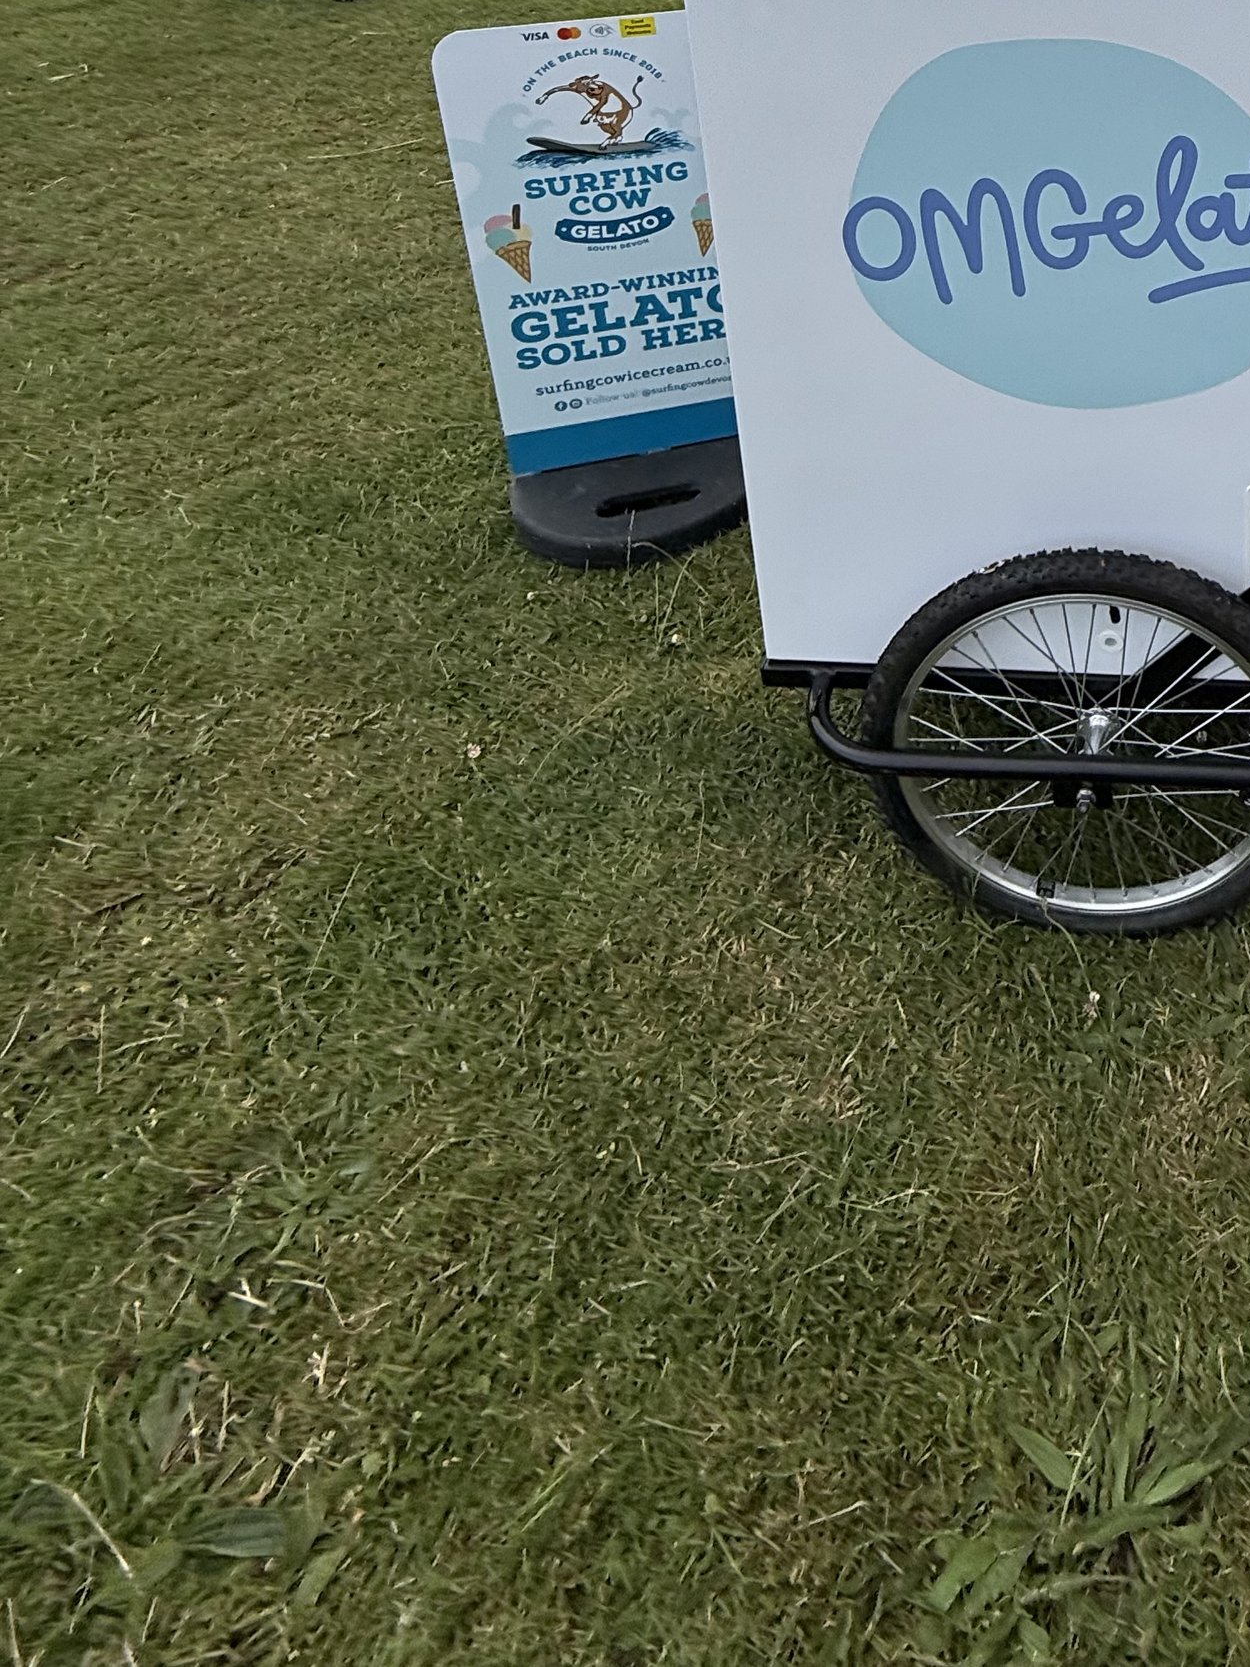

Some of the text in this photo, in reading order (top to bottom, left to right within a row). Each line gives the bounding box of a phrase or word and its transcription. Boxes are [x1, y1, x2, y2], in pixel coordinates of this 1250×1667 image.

[521, 31, 550, 42] VISA
[522, 77, 537, 92] ON
[534, 60, 557, 77] THE
[557, 47, 598, 63] BEACH
[602, 47, 638, 63] SINCE
[524, 161, 688, 199] SURFING
[568, 187, 651, 215] COW
[570, 214, 660, 240] GELATO
[587, 244, 617, 252] SOUTH
[516, 318, 727, 370] SOLD HER
[641, 375, 732, 398] @surfingcowdevo
